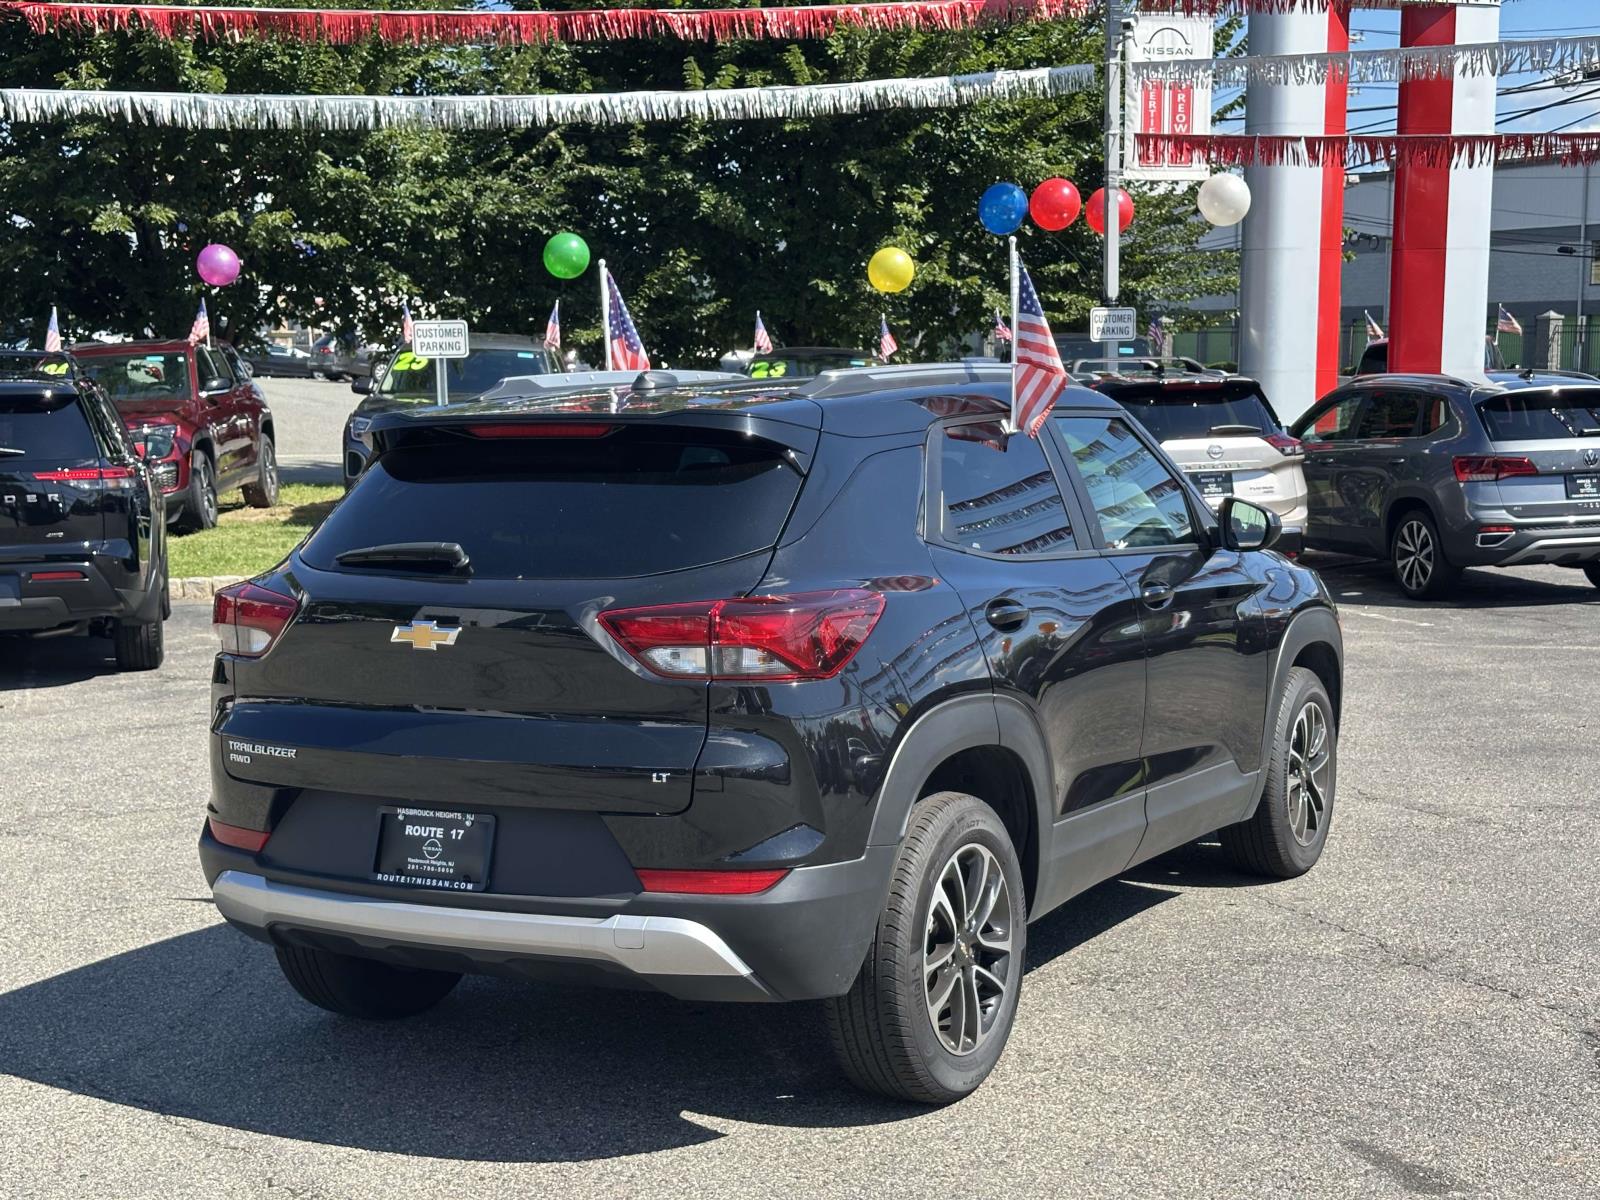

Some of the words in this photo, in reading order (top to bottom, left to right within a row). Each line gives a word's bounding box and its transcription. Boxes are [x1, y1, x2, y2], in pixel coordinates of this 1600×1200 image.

[1143, 47, 1193, 56] NISSAN
[1094, 314, 1132, 323] CUSTOMER
[416, 328, 463, 338] CUSTOMER
[1096, 326, 1130, 336] PARKING
[420, 341, 461, 351] PARKING
[228, 741, 297, 758] TRAILBLAZER
[230, 753, 251, 764] AWD
[652, 772, 671, 783] LT
[397, 808, 434, 817] HASBROUCK
[405, 825, 444, 838] ROUTE
[450, 829, 465, 840] 17
[376, 874, 474, 890] ROUTE17NISSAN.COM
